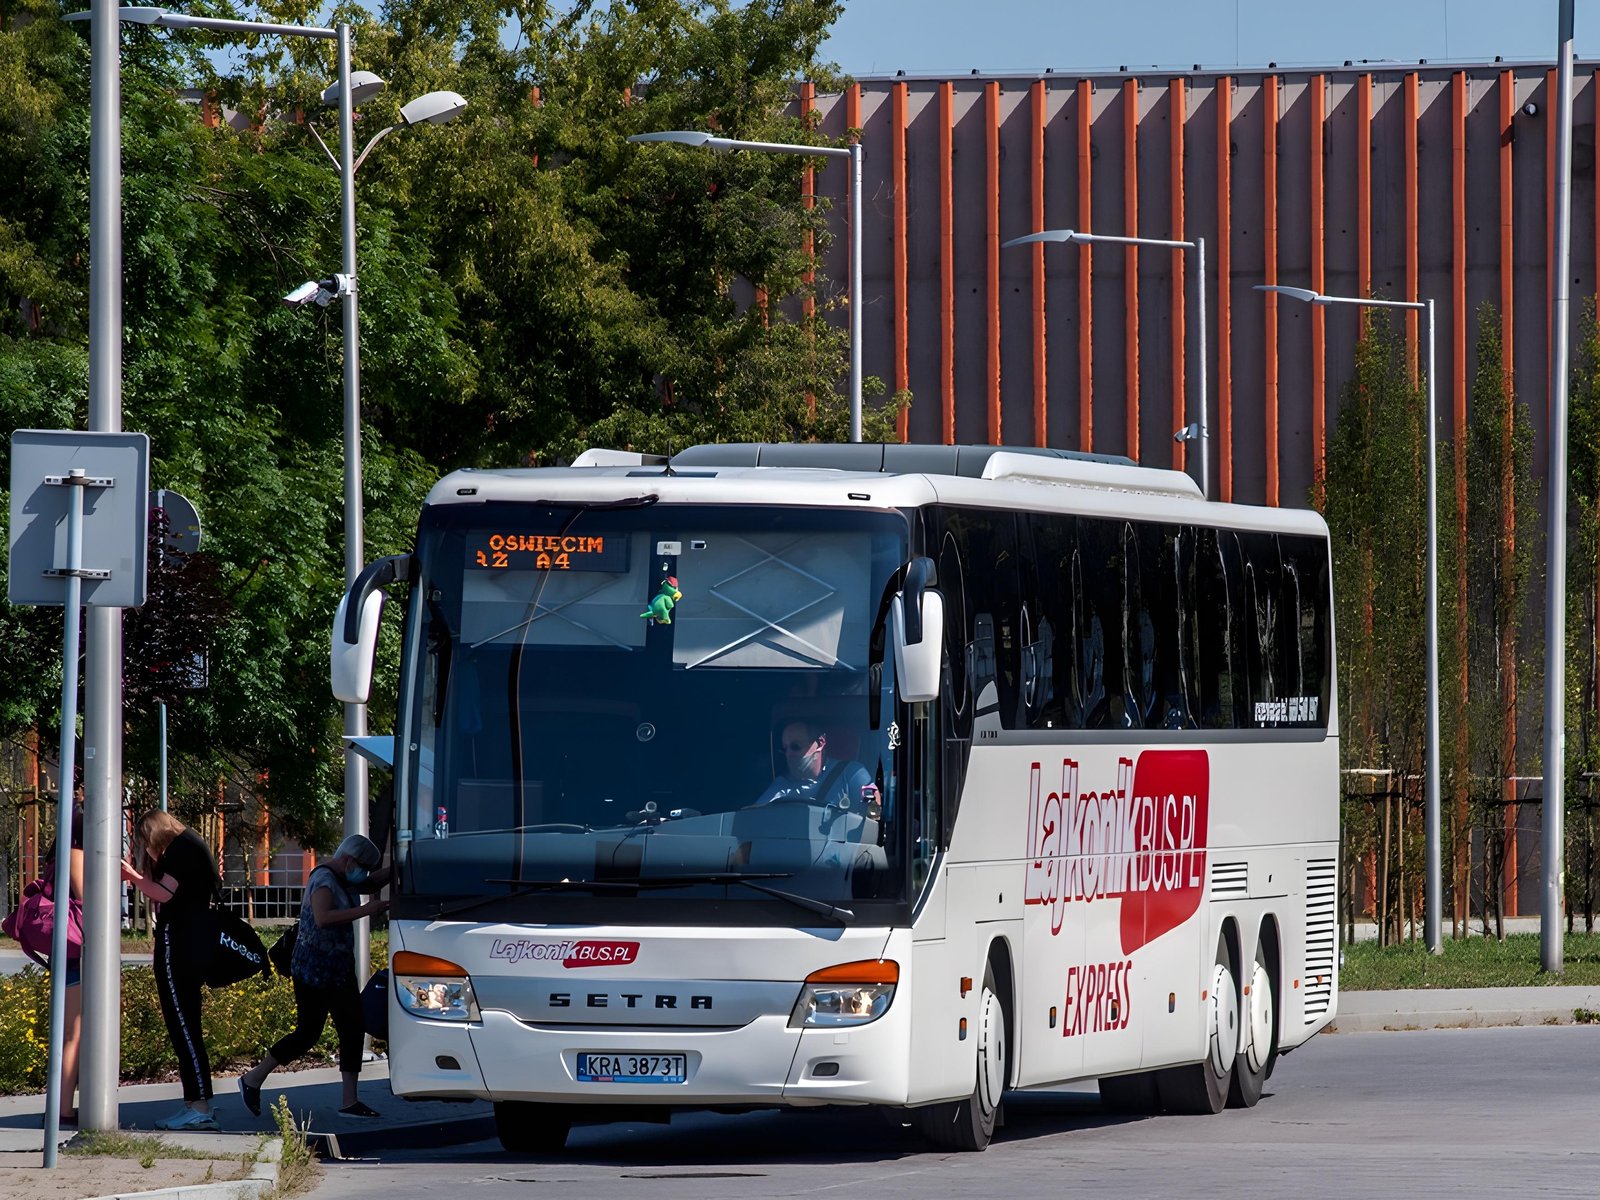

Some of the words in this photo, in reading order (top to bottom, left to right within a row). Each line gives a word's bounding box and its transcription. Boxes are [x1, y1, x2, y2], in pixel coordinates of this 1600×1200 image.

[536, 552, 570, 569] A4
[549, 993, 713, 1009] SETRA
[1062, 959, 1132, 1037] EXPRESS
[588, 1056, 622, 1076] KRA
[628, 1057, 683, 1077] 3873T
